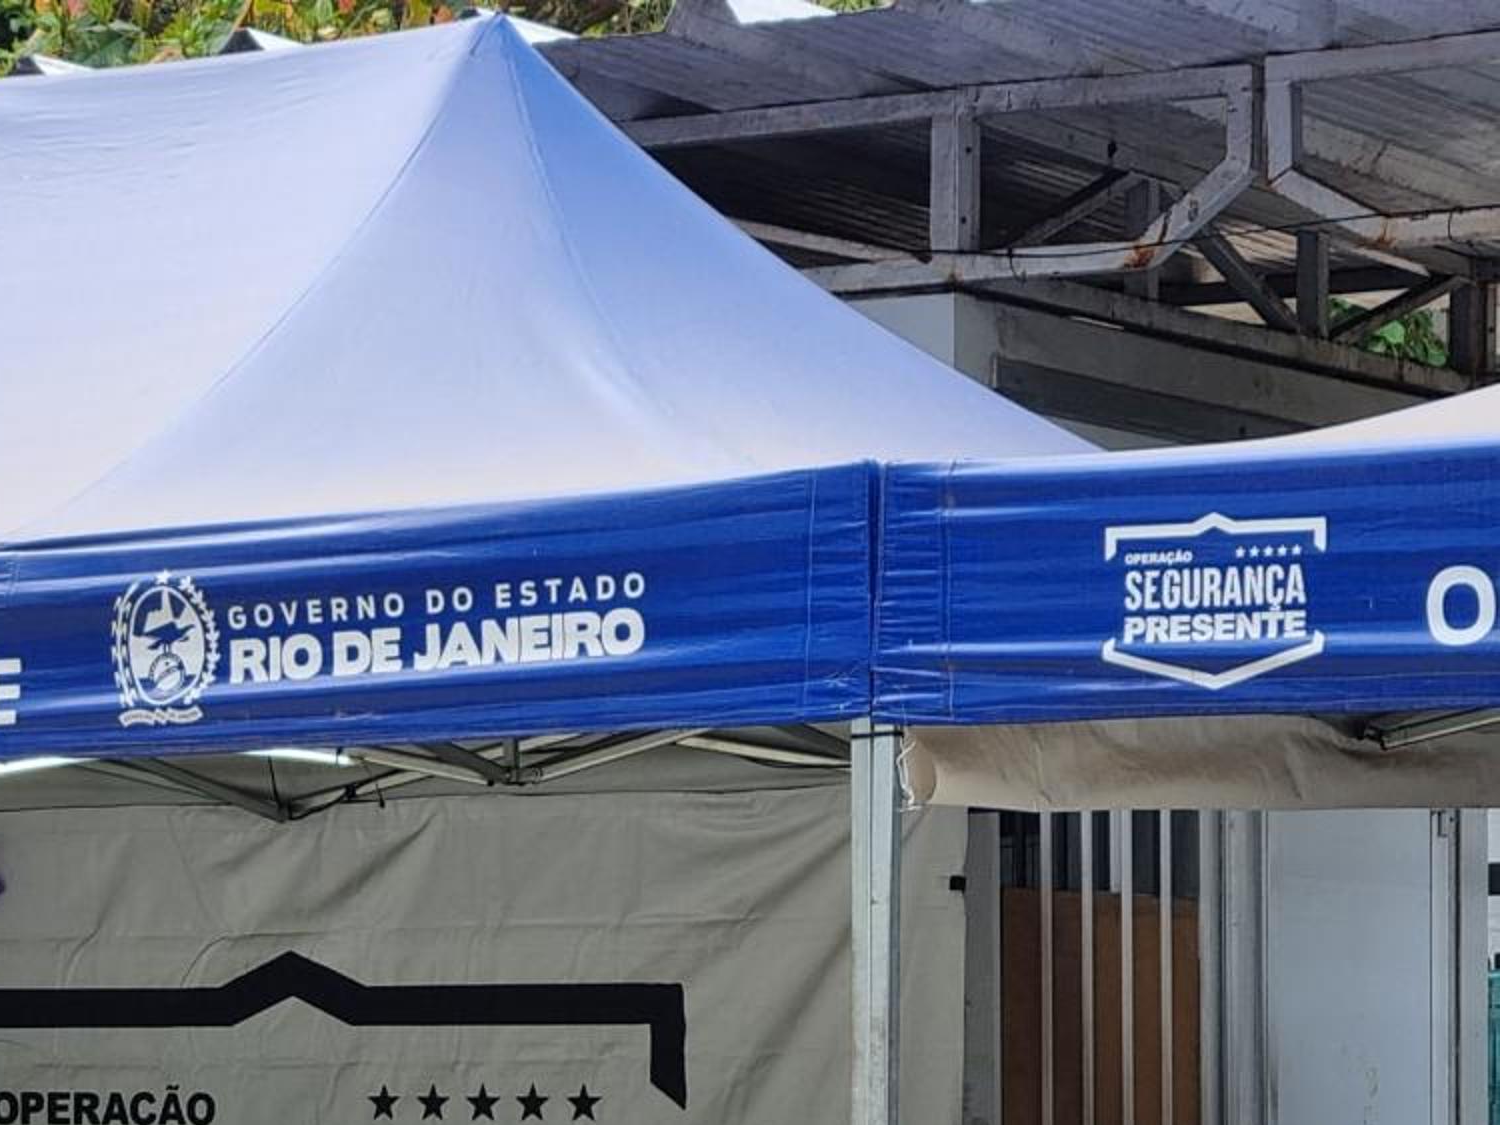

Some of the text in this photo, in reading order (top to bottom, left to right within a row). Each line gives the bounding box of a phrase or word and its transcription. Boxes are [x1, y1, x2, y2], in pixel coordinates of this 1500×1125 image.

[1124, 547, 1194, 566] OPERAÇÃO
[227, 571, 646, 630] GOVERNO DO ESTADO
[1124, 562, 1306, 613] SEGURANÇA
[229, 606, 646, 684] RIO DE JANEIRO
[1123, 609, 1307, 645] PRESENTE
